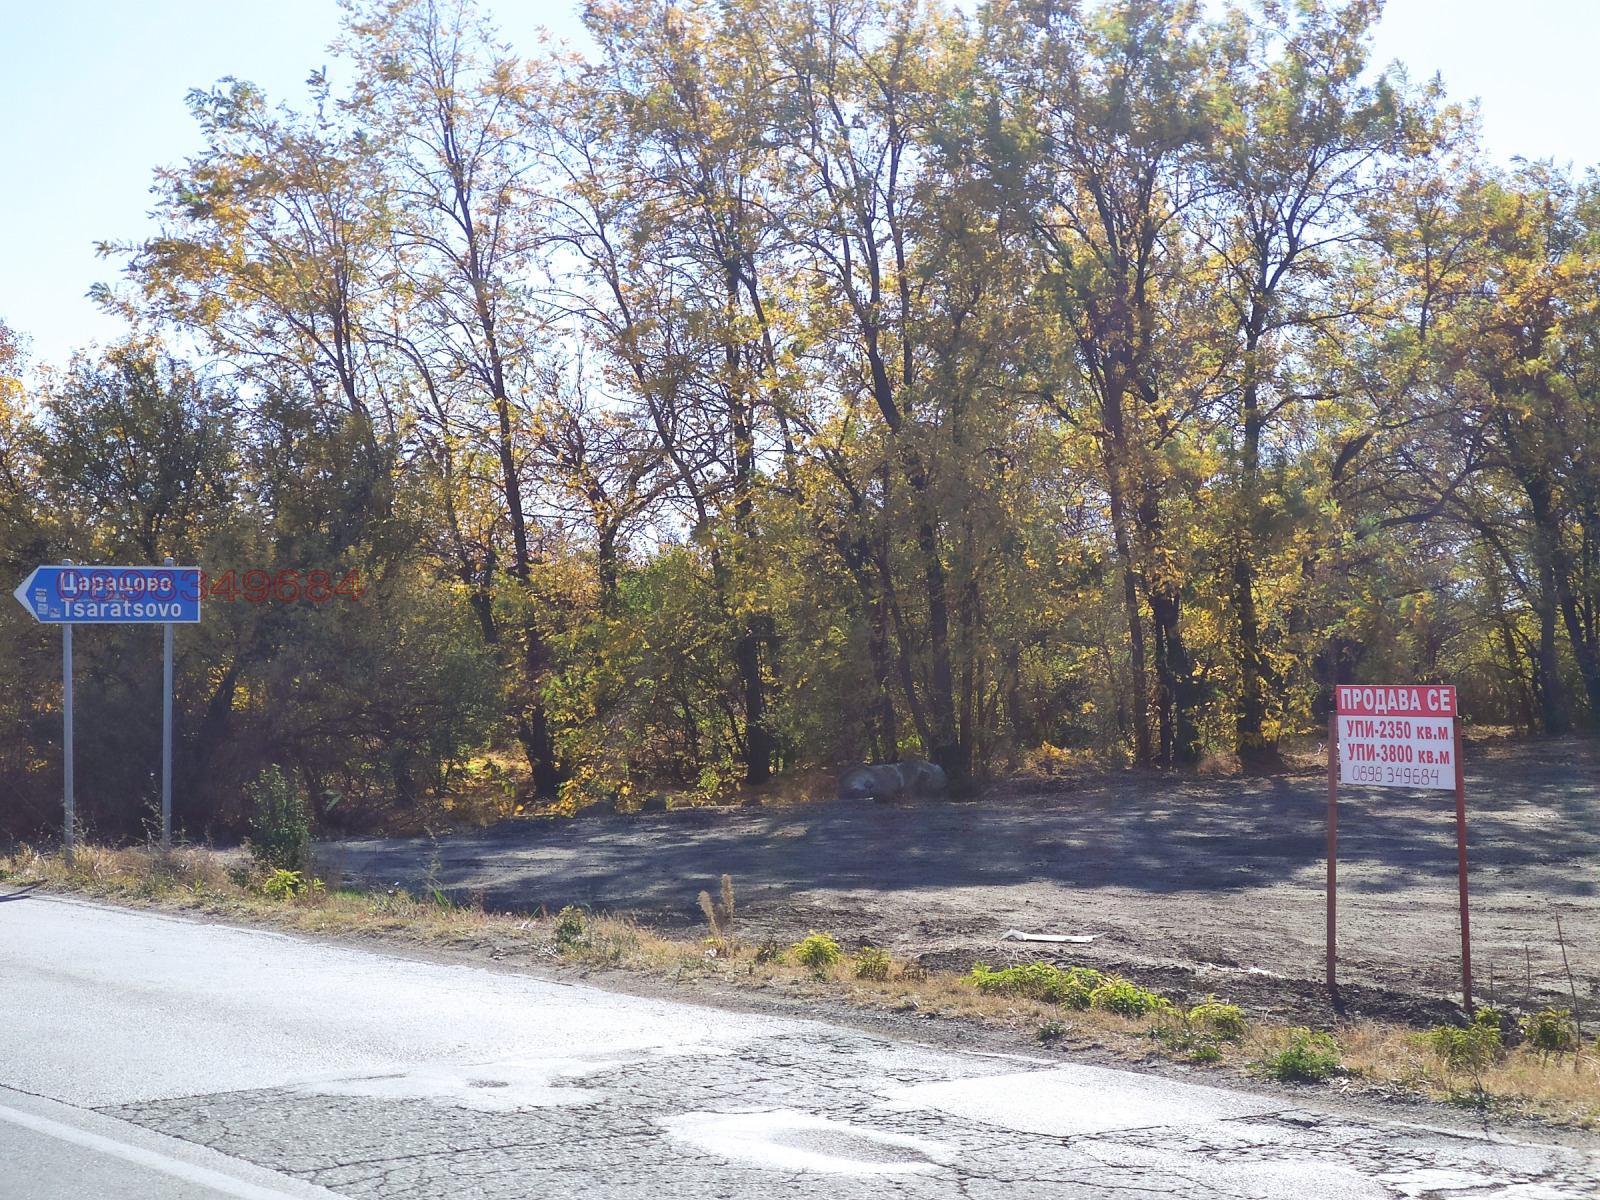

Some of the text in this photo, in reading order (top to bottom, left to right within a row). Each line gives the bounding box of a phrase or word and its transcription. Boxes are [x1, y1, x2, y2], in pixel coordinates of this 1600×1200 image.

[60, 572, 171, 595] Царацово
[60, 598, 182, 618] Tsaratsovo
[1340, 688, 1451, 714] ПРОДАВА СЕ
[1347, 720, 1411, 739] УПИ-2350
[1348, 743, 1413, 763] УПИ-3800
[1352, 765, 1439, 785] 0898 349684
